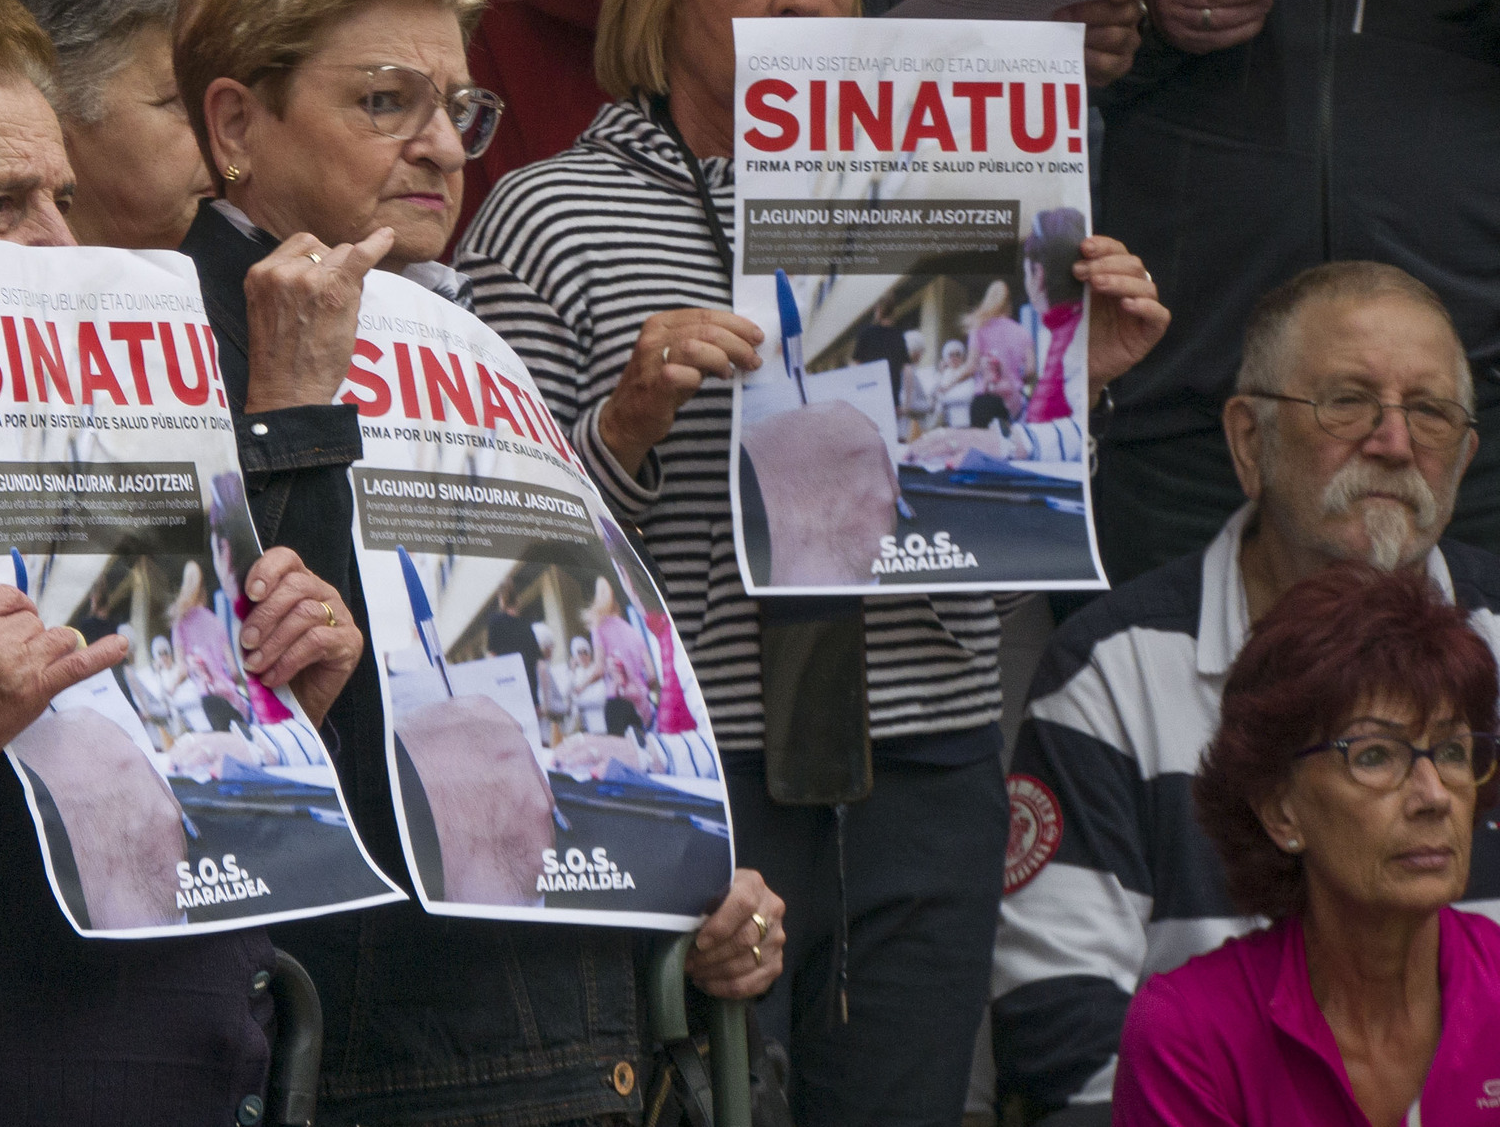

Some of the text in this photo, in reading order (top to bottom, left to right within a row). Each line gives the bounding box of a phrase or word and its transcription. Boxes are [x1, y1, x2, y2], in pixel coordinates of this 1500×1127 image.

[749, 56, 1080, 75] OSASUN SISTEMA PUBLIKO ETA DUINAREN ALDE
[743, 78, 1083, 154] SINATU!
[746, 160, 791, 173] FIRMA
[794, 160, 823, 173] POR
[827, 160, 846, 173] UN
[850, 160, 908, 173] SISTEMA
[912, 161, 929, 173] DE
[933, 161, 975, 174] SALUD
[979, 158, 1034, 174] PÚBLICO
[1036, 161, 1045, 174] Y
[749, 208, 1013, 225] LAGUNDU SINADURAK JASOTZEN!
[42, 293, 97, 311] PUBLIKO
[101, 293, 125, 311] ETA
[126, 293, 185, 312] DUINAREN
[340, 337, 586, 476] SINATU!
[4, 414, 27, 429] POR
[30, 414, 47, 429] UN
[50, 414, 94, 430] SISTEMA
[95, 416, 111, 430] DE
[112, 416, 149, 430] SALUD
[152, 412, 198, 431] PÚBLICO
[201, 416, 210, 430] Y
[361, 426, 543, 461] RMA POR UN SISTEMA DE SALUD
[42, 473, 118, 493] SINADURAK
[118, 473, 195, 493] JASOTZEN!
[362, 478, 436, 499] LAGUNDU
[438, 483, 523, 508] SINADURAK
[524, 492, 588, 521] JASOTZEN!
[880, 530, 960, 559] S.O.S.
[870, 551, 980, 574] AIARALDEA
[176, 853, 249, 890] S.O.S.
[541, 847, 618, 874] S.O.S.
[175, 877, 271, 909] AIARALDEA
[536, 871, 636, 892] AIARALDEA
